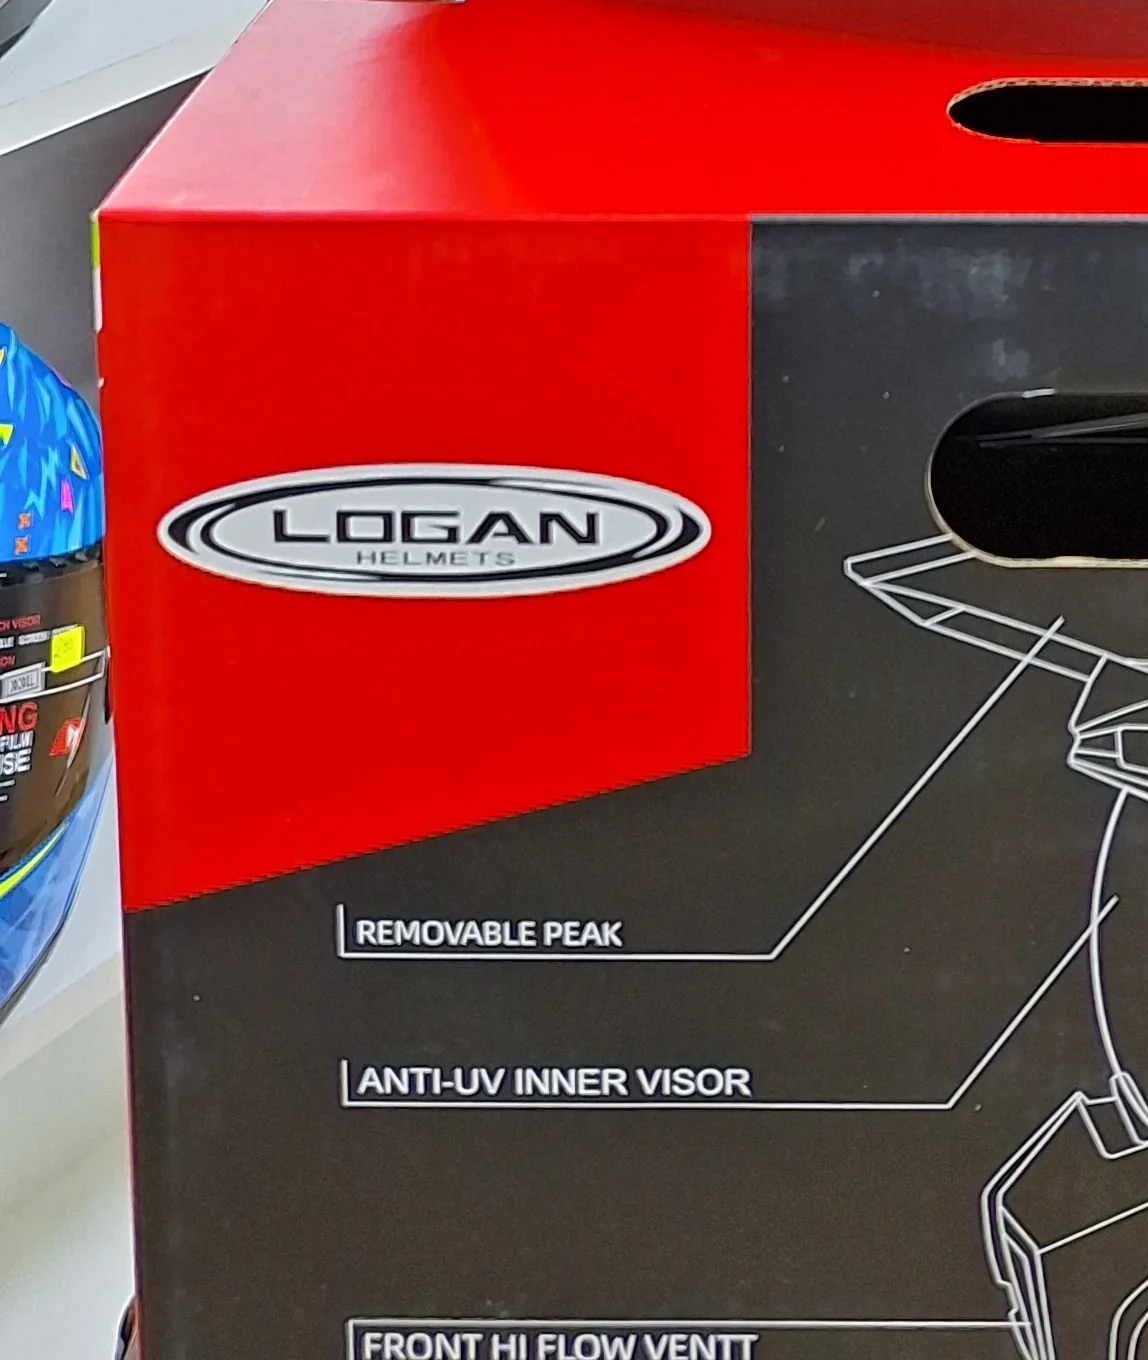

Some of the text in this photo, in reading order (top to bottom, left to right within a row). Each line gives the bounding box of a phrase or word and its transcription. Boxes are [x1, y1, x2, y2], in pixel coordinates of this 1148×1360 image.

[273, 509, 599, 545] LOGAN
[355, 549, 517, 568] HELMETS
[356, 919, 624, 948] REMOVABLE PEAK
[357, 1065, 753, 1097] ANTI-UV INNER VISOR
[362, 1331, 484, 1360] FRONT
[489, 1332, 527, 1360] HI
[537, 1332, 638, 1360] FLOW
